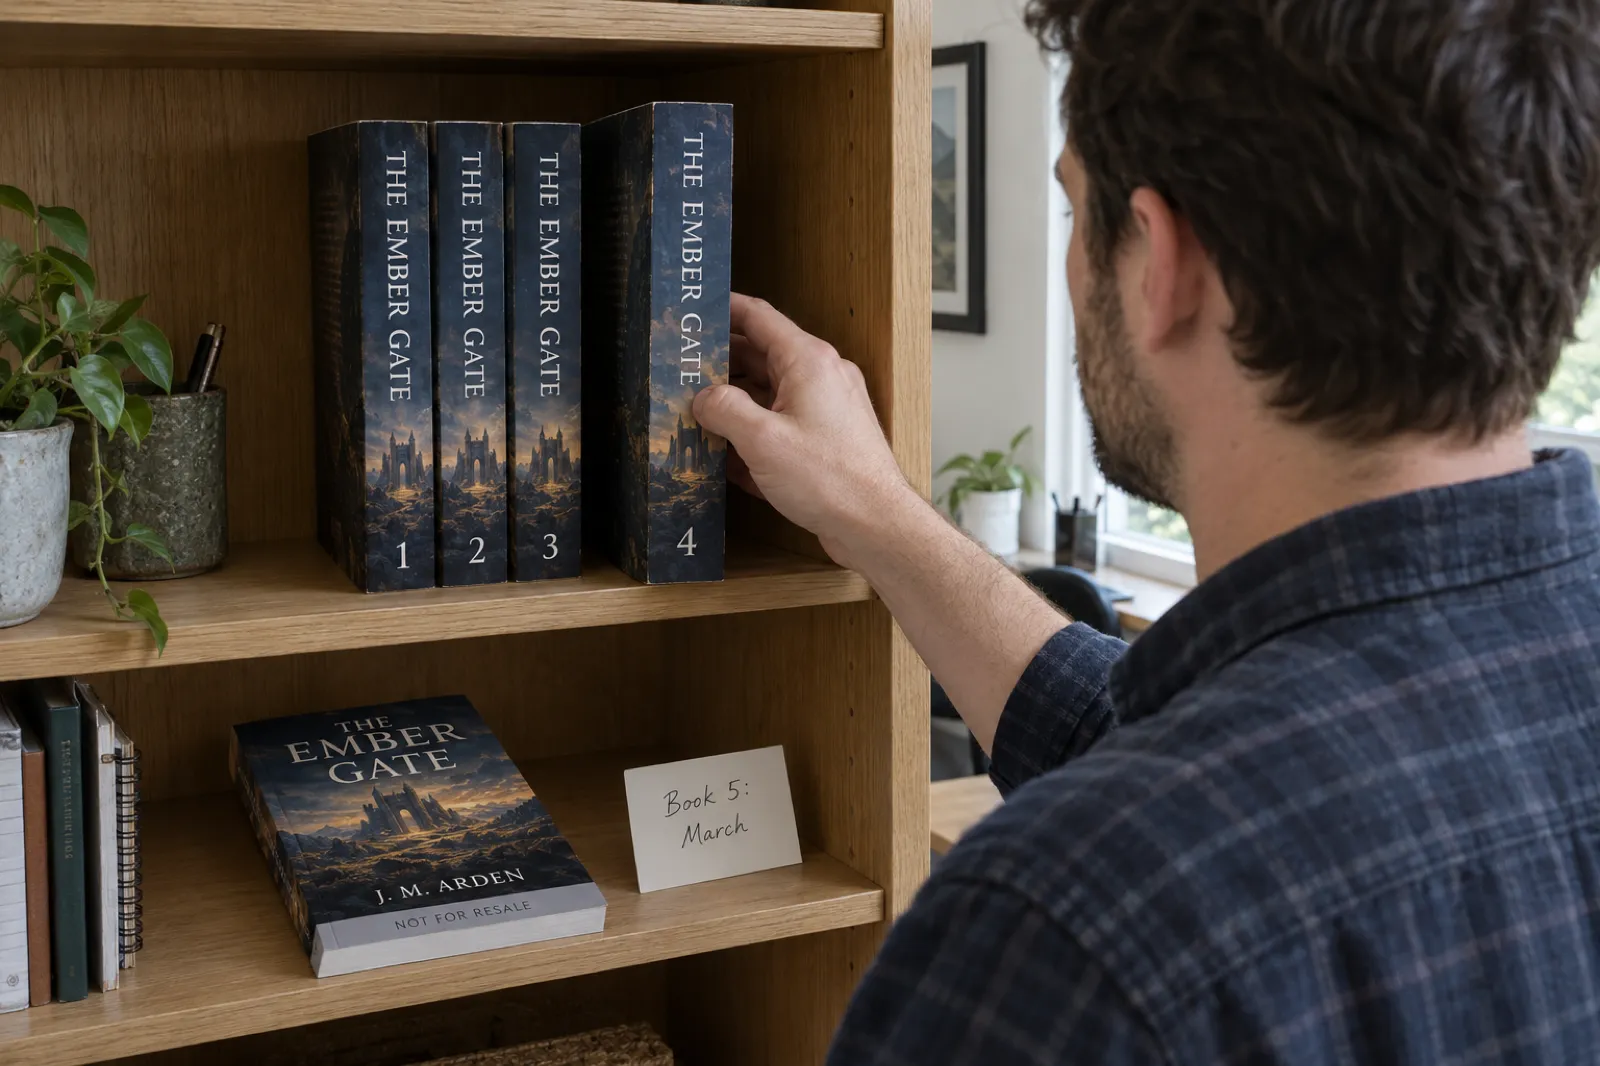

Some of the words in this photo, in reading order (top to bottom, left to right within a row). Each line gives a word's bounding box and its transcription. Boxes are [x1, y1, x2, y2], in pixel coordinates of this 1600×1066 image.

[386, 150, 407, 206] THE
[461, 151, 482, 206] THE
[539, 152, 559, 207] THE
[682, 132, 704, 188] THE
[386, 219, 410, 320] EMBER
[461, 218, 484, 318] EMBER
[539, 219, 560, 316] EMBER
[680, 201, 704, 303] EMBER
[388, 329, 411, 402] GATE
[463, 327, 485, 399] GATE
[539, 327, 561, 397] GATE
[679, 312, 702, 386] GATE
[396, 541, 410, 569] 1
[468, 536, 486, 564] 2
[542, 533, 559, 560] 3
[676, 527, 697, 557] 4
[285, 723, 468, 764] EMBER
[334, 716, 393, 733] THE
[328, 748, 457, 784] GATE
[663, 784, 717, 818] Book
[727, 779, 749, 801] 5:
[681, 812, 749, 849] March
[375, 889, 393, 906] J.
[400, 883, 430, 899] M.
[439, 868, 525, 893] ARDEN
[394, 916, 429, 930] NOT
[435, 910, 468, 924] FOR
[473, 901, 533, 918] RESALE
